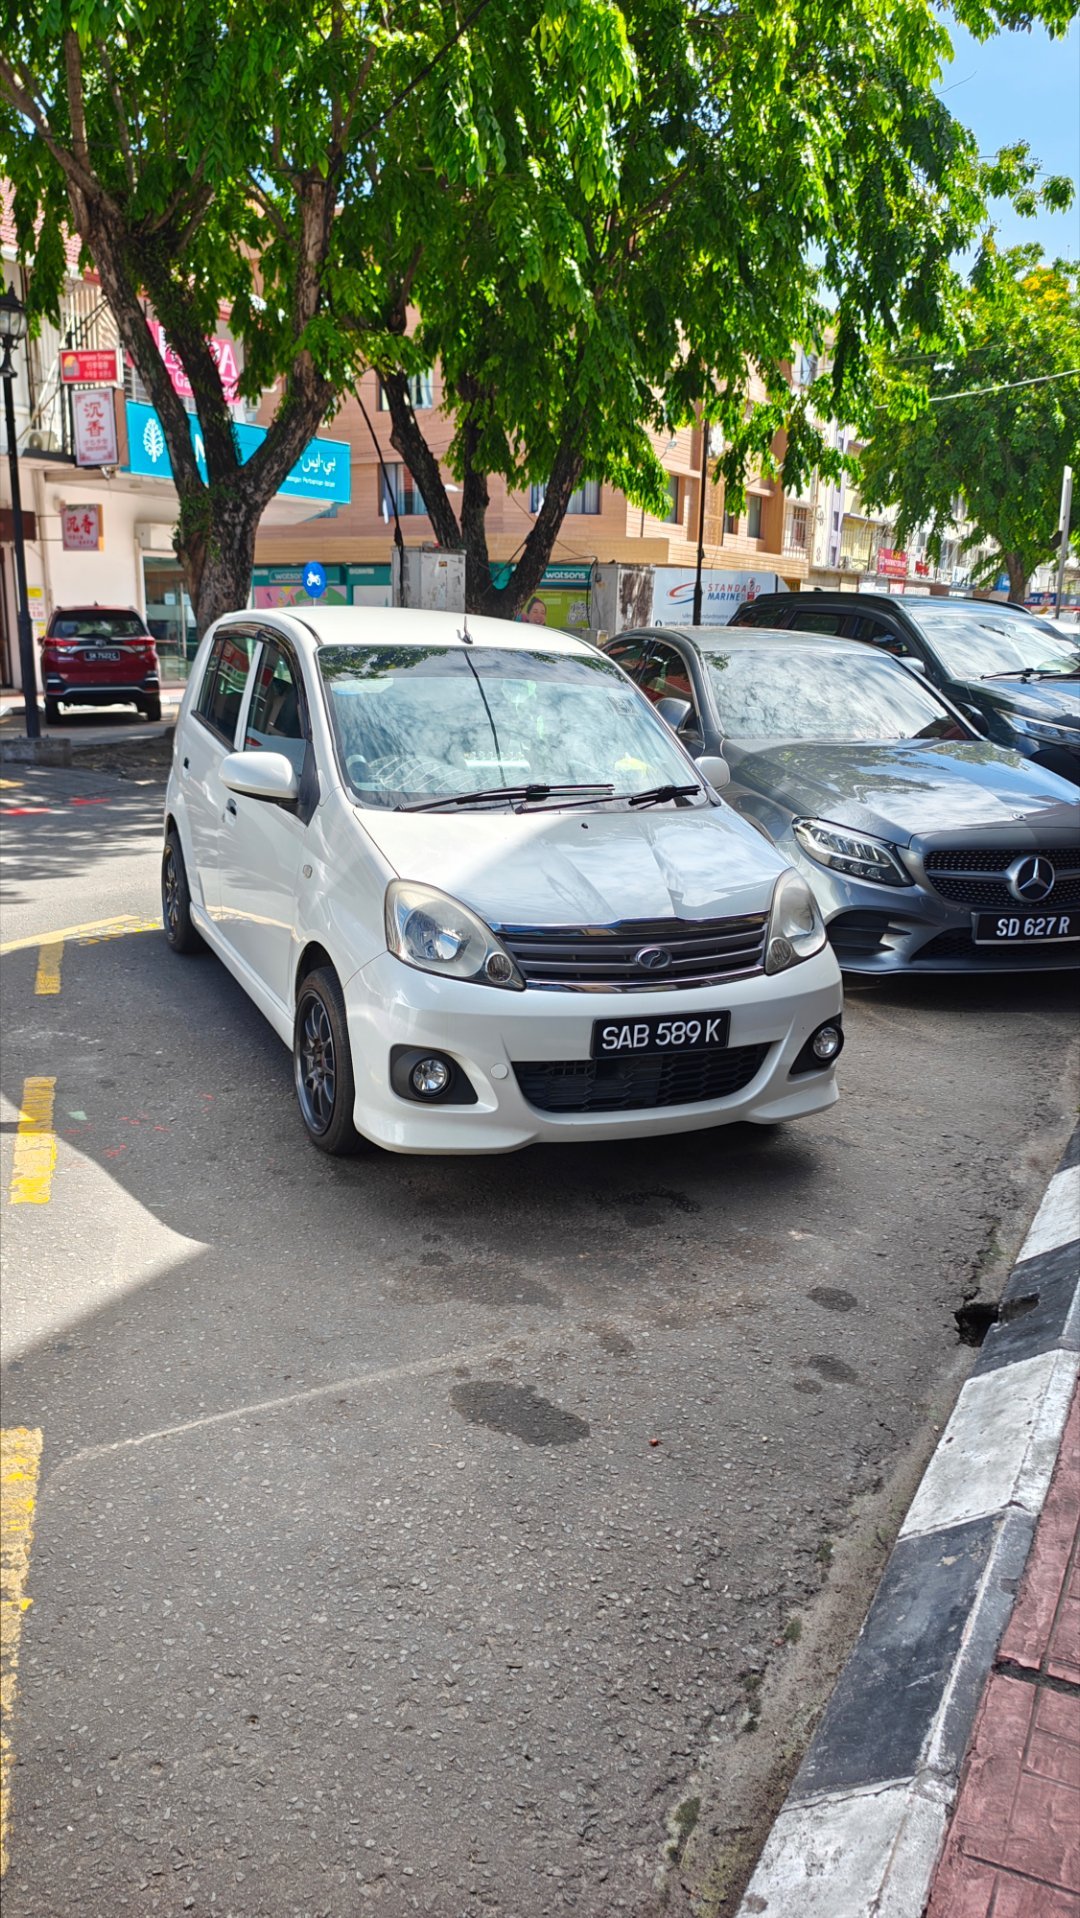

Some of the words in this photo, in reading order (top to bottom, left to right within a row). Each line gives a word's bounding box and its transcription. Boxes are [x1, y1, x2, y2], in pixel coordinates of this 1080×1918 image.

[545, 571, 586, 579] watsons
[707, 592, 740, 601] MARINE
[996, 918, 1020, 937] SD
[1023, 917, 1057, 936] 627
[1058, 916, 1070, 934] R
[602, 1024, 650, 1050] SAB
[655, 1020, 702, 1046] 589
[705, 1018, 722, 1043] K
